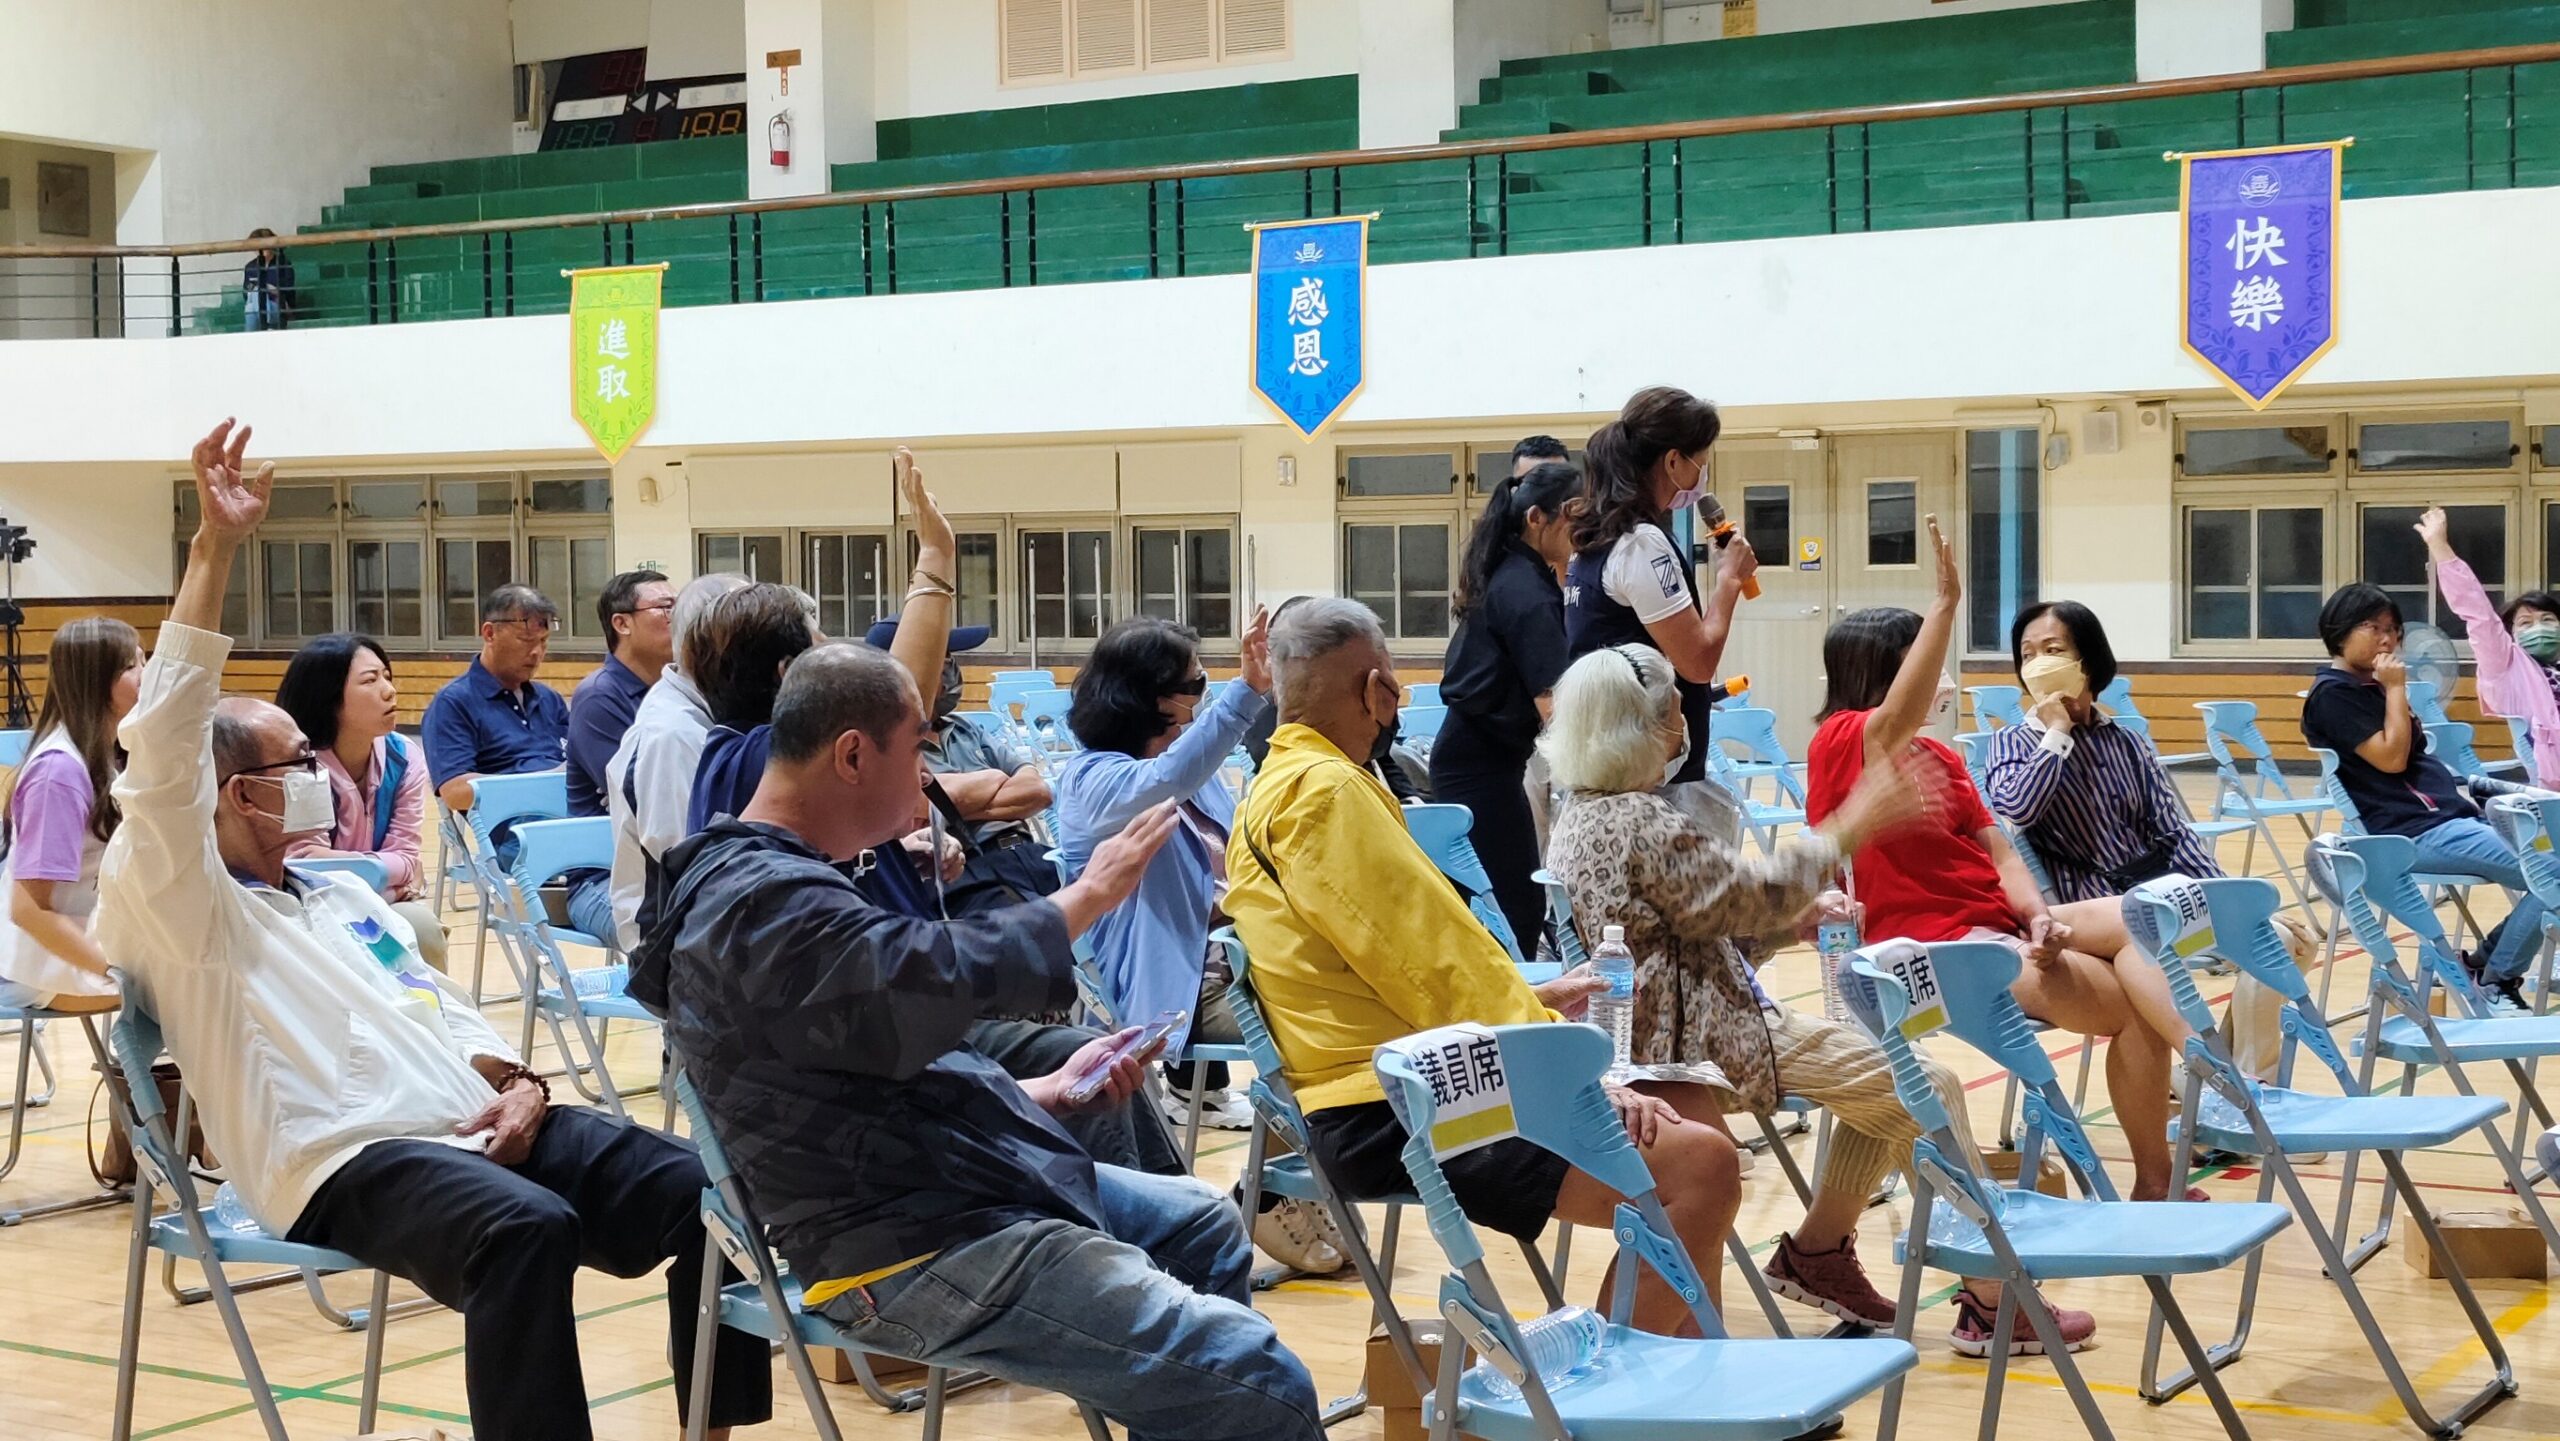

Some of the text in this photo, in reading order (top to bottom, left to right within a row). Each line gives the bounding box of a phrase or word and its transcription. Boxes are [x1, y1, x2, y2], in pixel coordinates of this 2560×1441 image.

[2225, 216, 2289, 332] 快樂
[597, 318, 631, 404] 進取
[1288, 277, 1330, 376] 感恩
[1884, 954, 1936, 1007] 員席
[1411, 1036, 1504, 1108] 議員席
